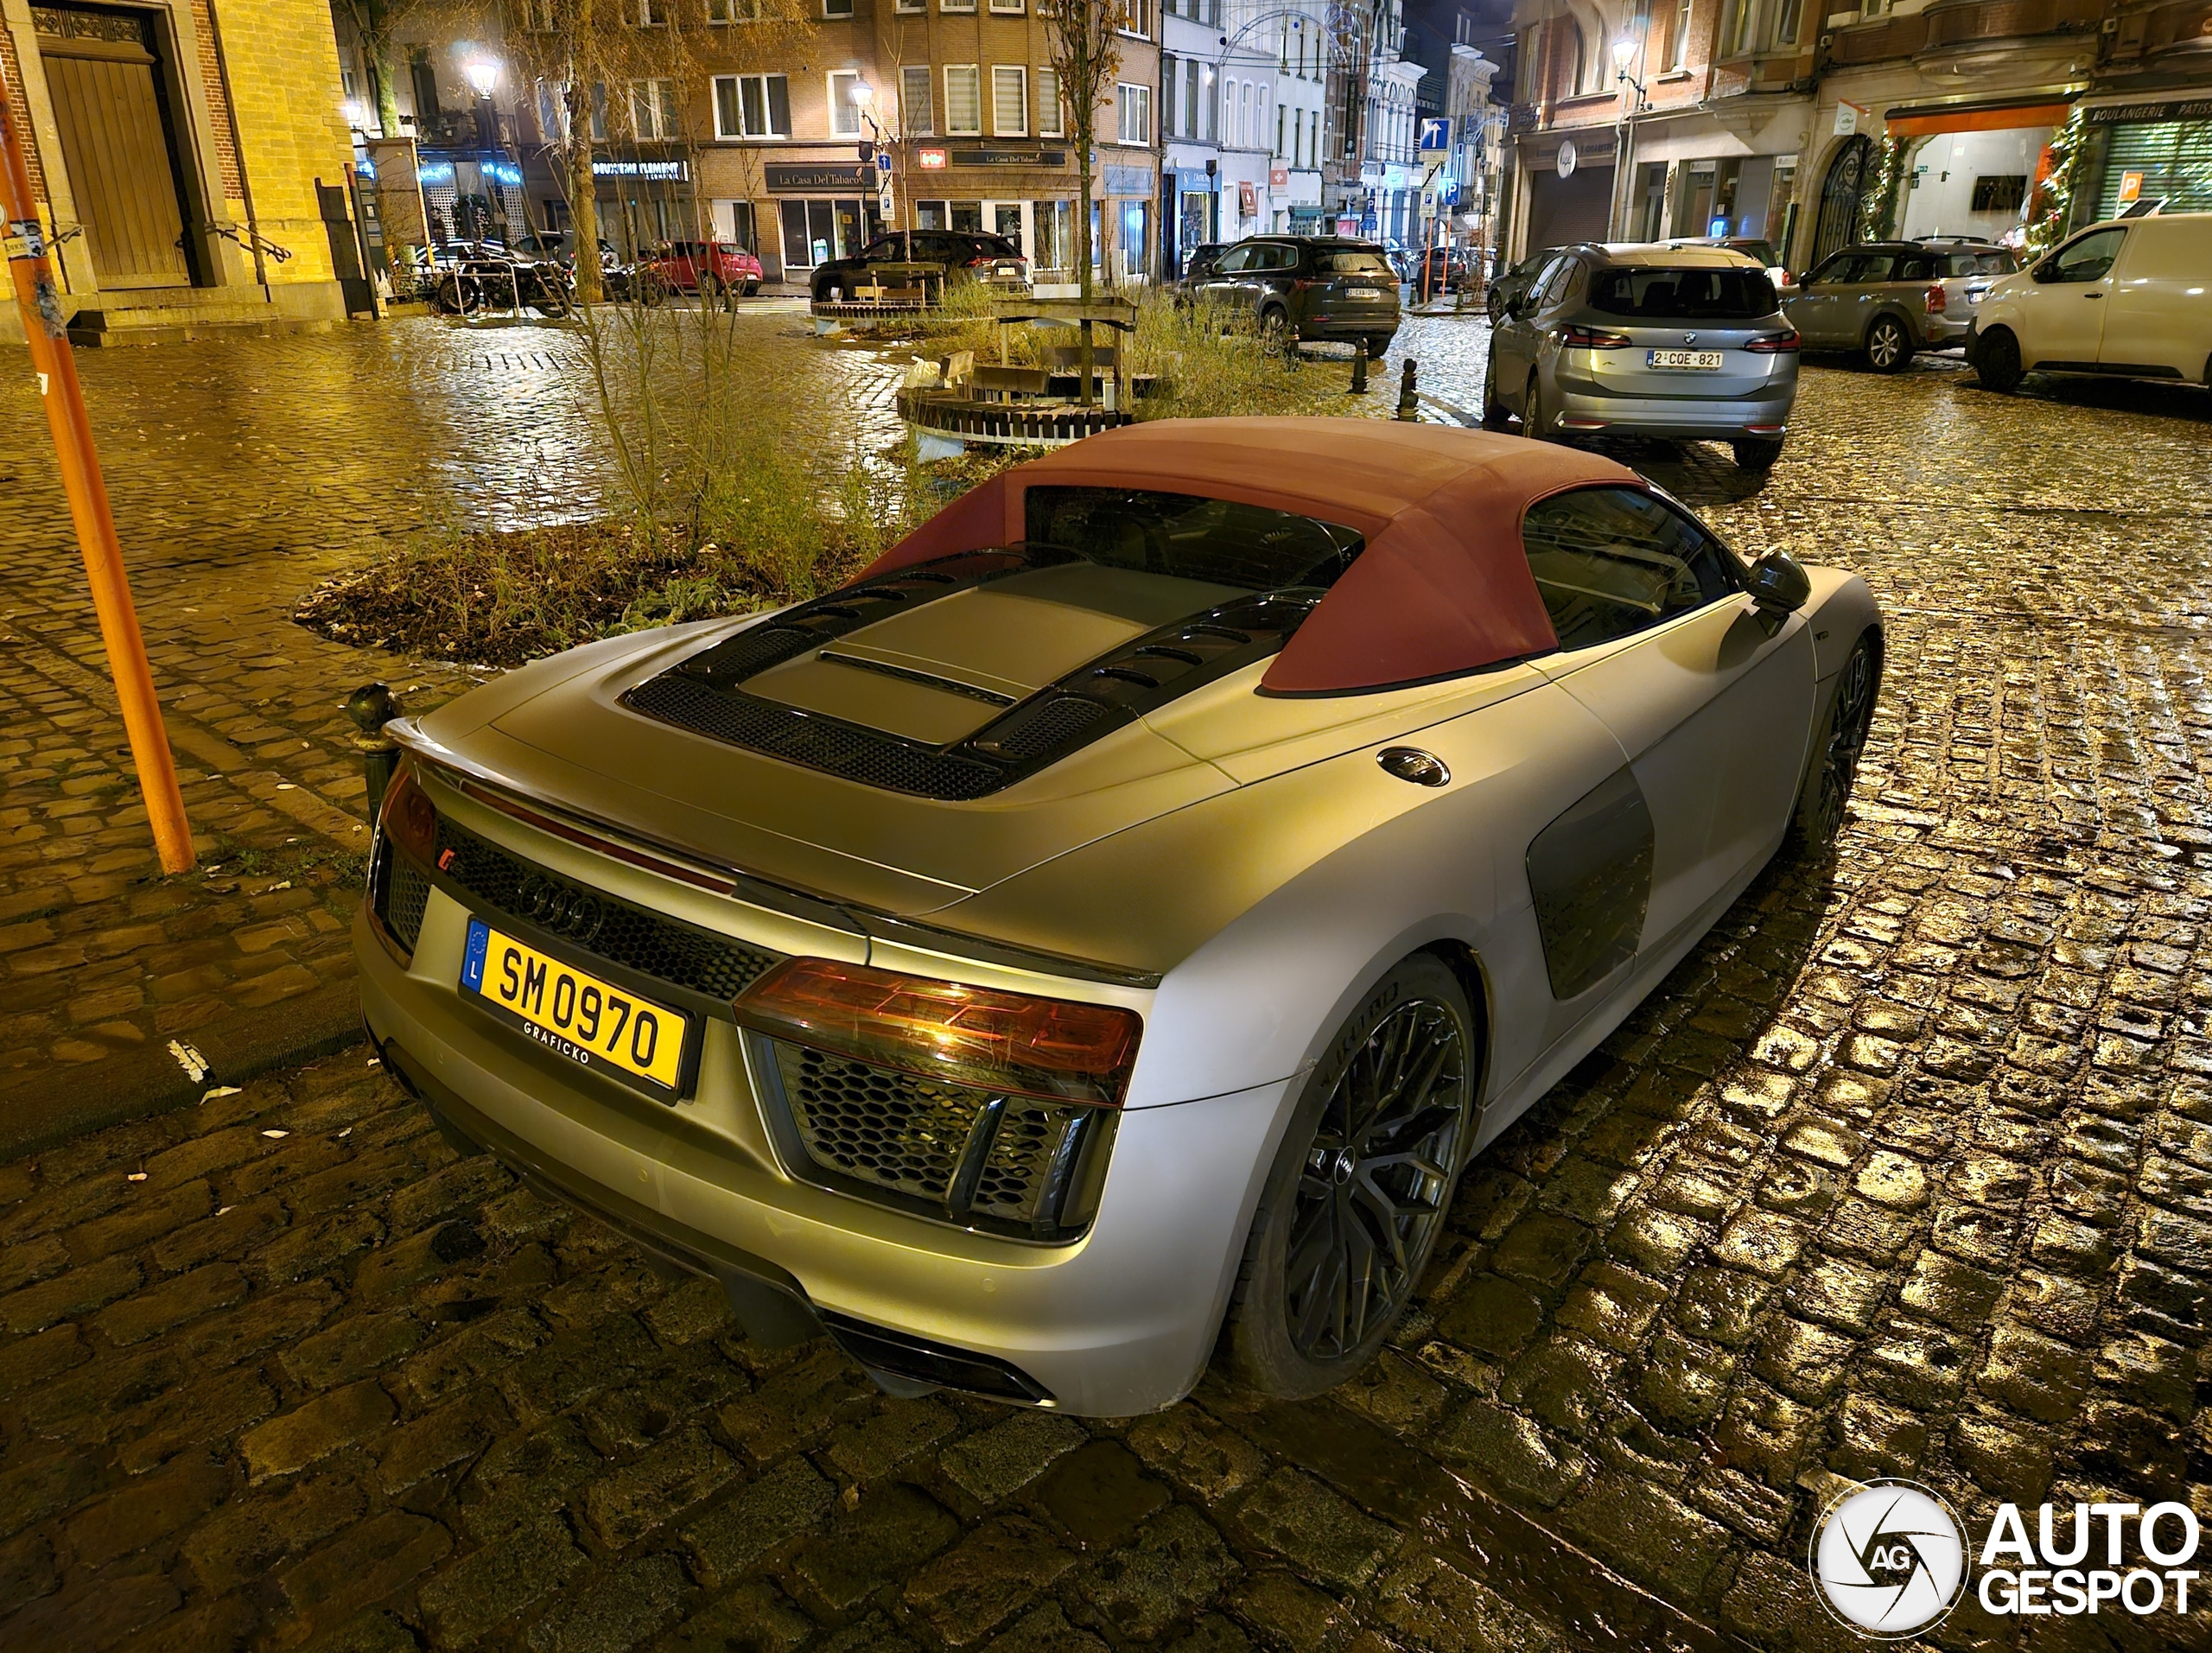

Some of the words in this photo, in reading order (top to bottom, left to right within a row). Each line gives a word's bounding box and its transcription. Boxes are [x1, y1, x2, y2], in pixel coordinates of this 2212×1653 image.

[2093, 105, 2166, 121] BOULANGERIE
[779, 174, 790, 185] La
[791, 174, 811, 185] Casa
[814, 173, 829, 184] Del
[830, 173, 859, 184] Tabaco
[2124, 178, 2137, 194] P
[1448, 184, 1457, 197] P
[1368, 200, 1374, 210] P
[470, 961, 478, 980] L
[500, 947, 547, 1016] SM
[553, 974, 658, 1068] 0970
[524, 1021, 589, 1065] GRAFICKO
